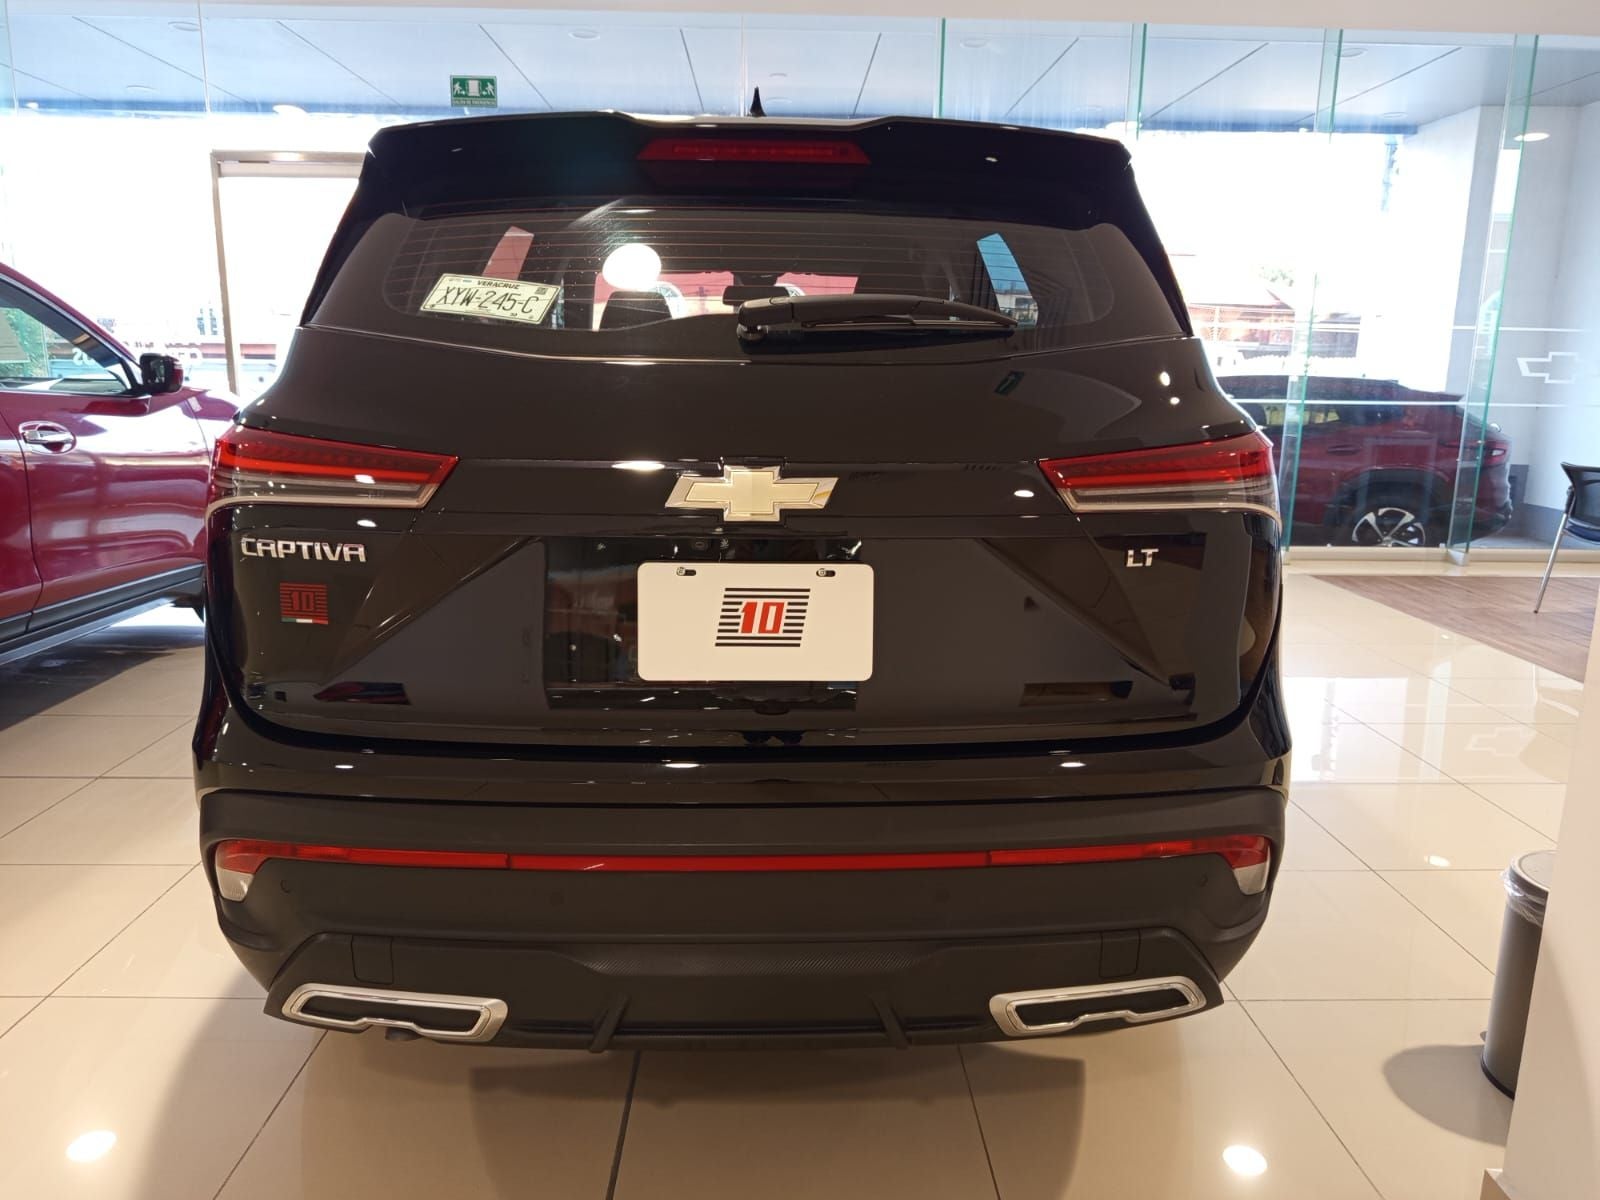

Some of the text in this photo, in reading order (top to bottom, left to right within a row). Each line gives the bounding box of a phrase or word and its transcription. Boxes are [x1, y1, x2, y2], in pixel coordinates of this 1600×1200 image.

[477, 280, 520, 290] VERACRUZ
[436, 286, 540, 314] XYW-245-C
[240, 537, 366, 562] CAPTIVA
[1126, 548, 1159, 567] LT
[291, 591, 315, 611] 10
[741, 601, 785, 634] 10
